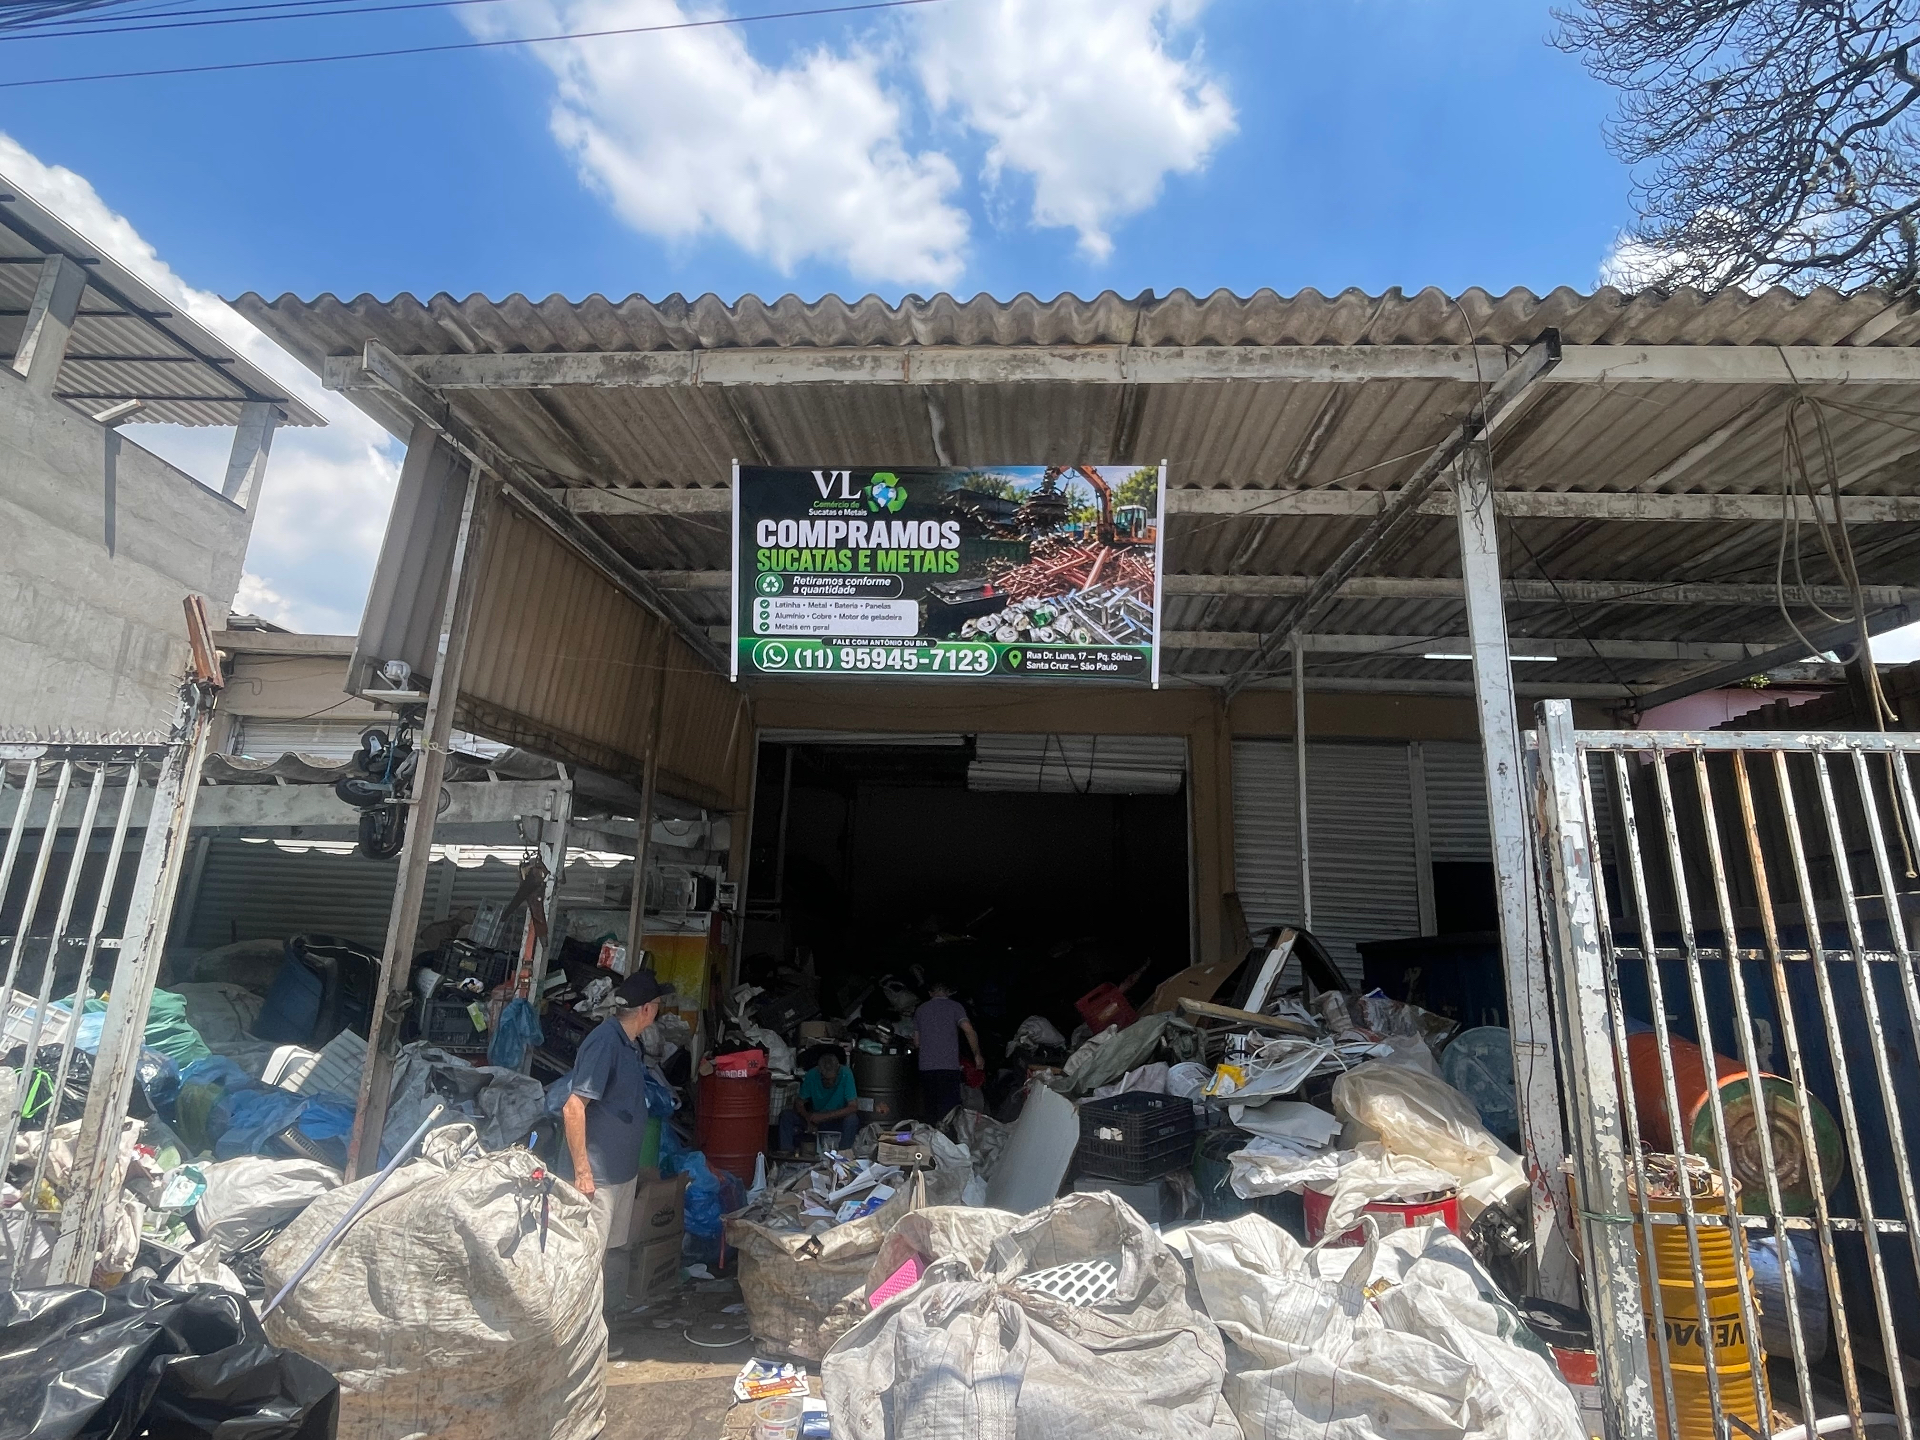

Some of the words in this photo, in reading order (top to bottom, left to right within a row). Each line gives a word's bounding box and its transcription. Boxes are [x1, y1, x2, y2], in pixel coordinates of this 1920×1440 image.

[811, 470, 862, 499] VL
[808, 508, 837, 516] Sucatas
[844, 508, 868, 516] Metais
[756, 519, 960, 550] COMPRAMOS
[756, 548, 852, 572] SUCATAS
[858, 549, 871, 573] E
[877, 550, 960, 574] METAIS
[792, 576, 847, 586] Retiramos
[847, 577, 891, 587] conforme
[801, 585, 856, 595] quantidade
[865, 602, 891, 610] Panelas
[775, 612, 805, 620] Alumínio
[871, 613, 902, 622] geladeira
[813, 624, 830, 632] geral
[869, 638, 902, 646] ANTÔNIO
[794, 648, 834, 669] (11)
[840, 647, 989, 671] 95945-7123
[1026, 651, 1041, 659] Rua
[1043, 651, 1054, 660] Dr.
[1056, 652, 1076, 661] Luna,
[1078, 652, 1086, 660] 17
[1097, 652, 1109, 662] Pq.
[1111, 652, 1133, 661] Sônia
[1026, 661, 1049, 670] Santa
[1050, 662, 1069, 670] Cruz
[1080, 662, 1095, 670] São
[1096, 662, 1118, 671] Paulo
